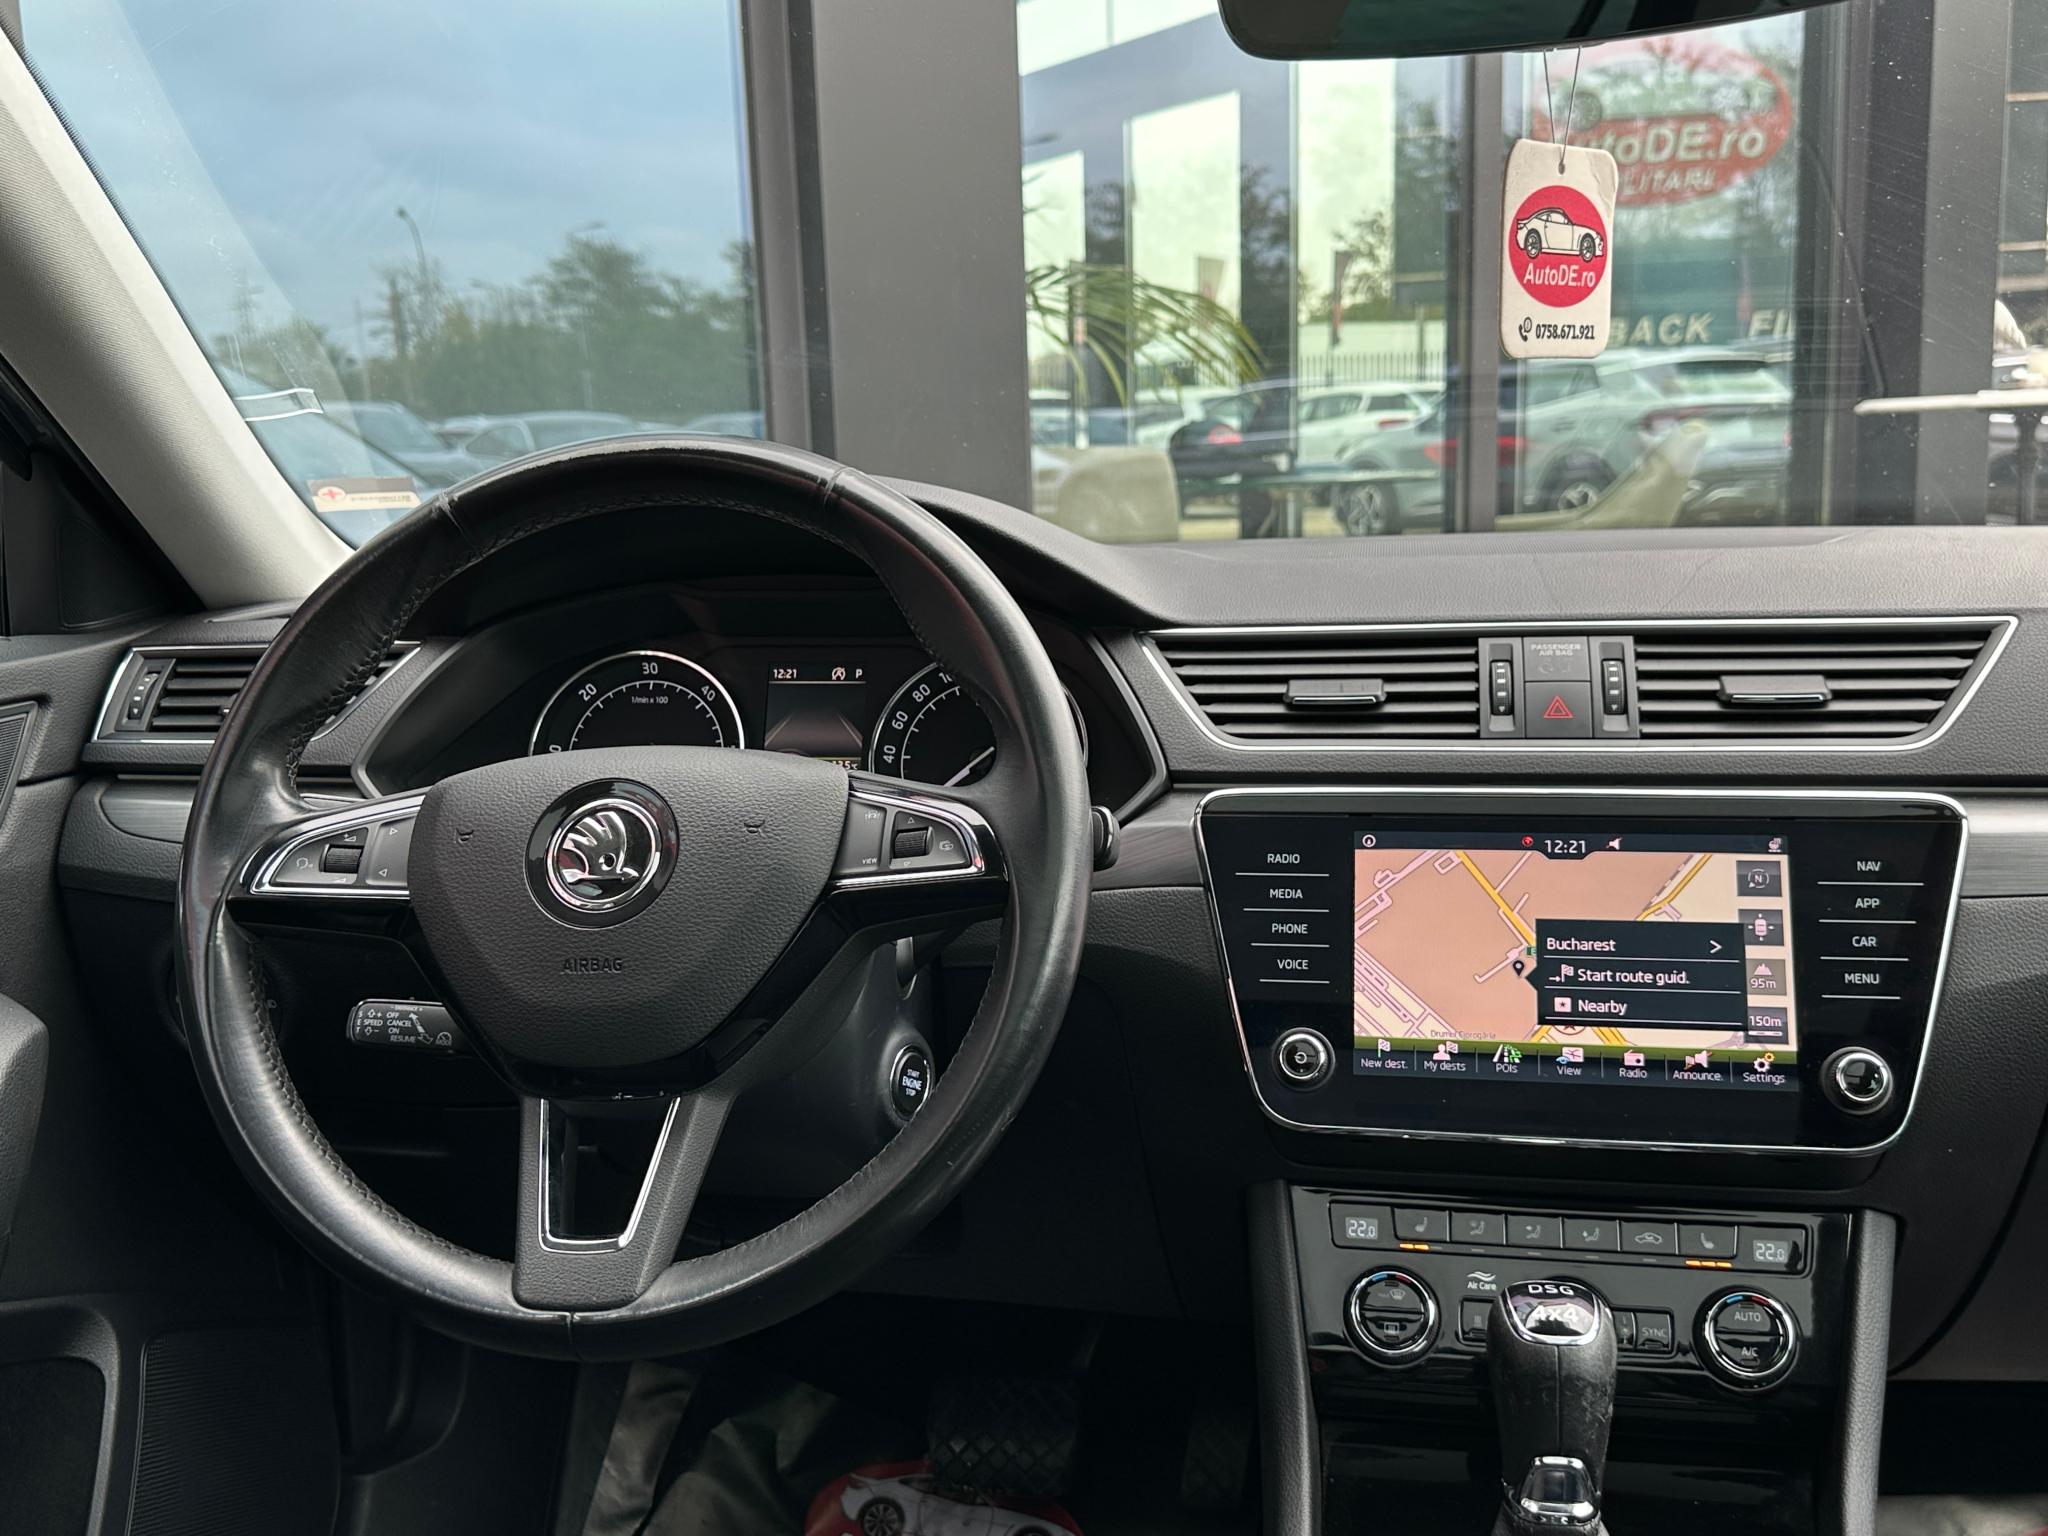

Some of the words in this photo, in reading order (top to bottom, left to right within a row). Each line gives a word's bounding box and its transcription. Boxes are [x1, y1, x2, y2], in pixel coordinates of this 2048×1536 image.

[1523, 262, 1596, 288] AutoDE.ro
[1535, 324, 1595, 340] 0758.671.921
[641, 662, 659, 675] 30
[773, 668, 797, 679] 12:21
[855, 668, 863, 679] P
[578, 683, 598, 701] 20
[701, 684, 717, 702] 40
[912, 684, 931, 702] 80
[656, 695, 669, 704] 100
[891, 711, 909, 730] 60
[883, 744, 897, 764] 40
[1544, 839, 1586, 854] 12:21
[862, 857, 878, 865] VIEW
[1267, 853, 1301, 864] RADIO
[1856, 861, 1881, 872] NAV
[1269, 888, 1303, 899] MEDIA
[1855, 898, 1880, 909] APP
[1271, 923, 1308, 934] PHONE
[1546, 937, 1616, 952] Bucharest
[1852, 936, 1877, 947] CAR
[561, 957, 623, 974] AIRBAG
[1277, 959, 1309, 970] VOICE
[1577, 968, 1613, 982] Start
[1615, 971, 1653, 983] route
[1655, 970, 1691, 986] guid.
[1844, 973, 1880, 984] MENU
[1750, 978, 1777, 989] 95m
[1578, 1000, 1628, 1015] Nearby
[386, 1011, 400, 1019] OFF
[363, 1018, 383, 1026] SPEED
[386, 1019, 412, 1027] CANCEL
[1749, 1015, 1782, 1027] 150m
[1360, 1058, 1382, 1068] New
[1384, 1059, 1408, 1069] dest.
[1423, 1060, 1437, 1072] My
[1440, 1061, 1466, 1071] dests
[1556, 1065, 1582, 1076] View
[1618, 1067, 1648, 1078] Radio
[1672, 1070, 1724, 1081] Announce.
[1742, 1072, 1785, 1085] Settings
[1348, 1221, 1376, 1237] 22.0
[1755, 1243, 1785, 1261] 22.0
[1467, 1281, 1477, 1290] Air
[1479, 1281, 1497, 1291] Care
[1527, 1284, 1575, 1296] DSG
[1532, 1304, 1580, 1324] 4x4
[1734, 1311, 1761, 1322] AUTO
[1641, 1326, 1668, 1338] SYNC
[1741, 1346, 1758, 1358] A/C
